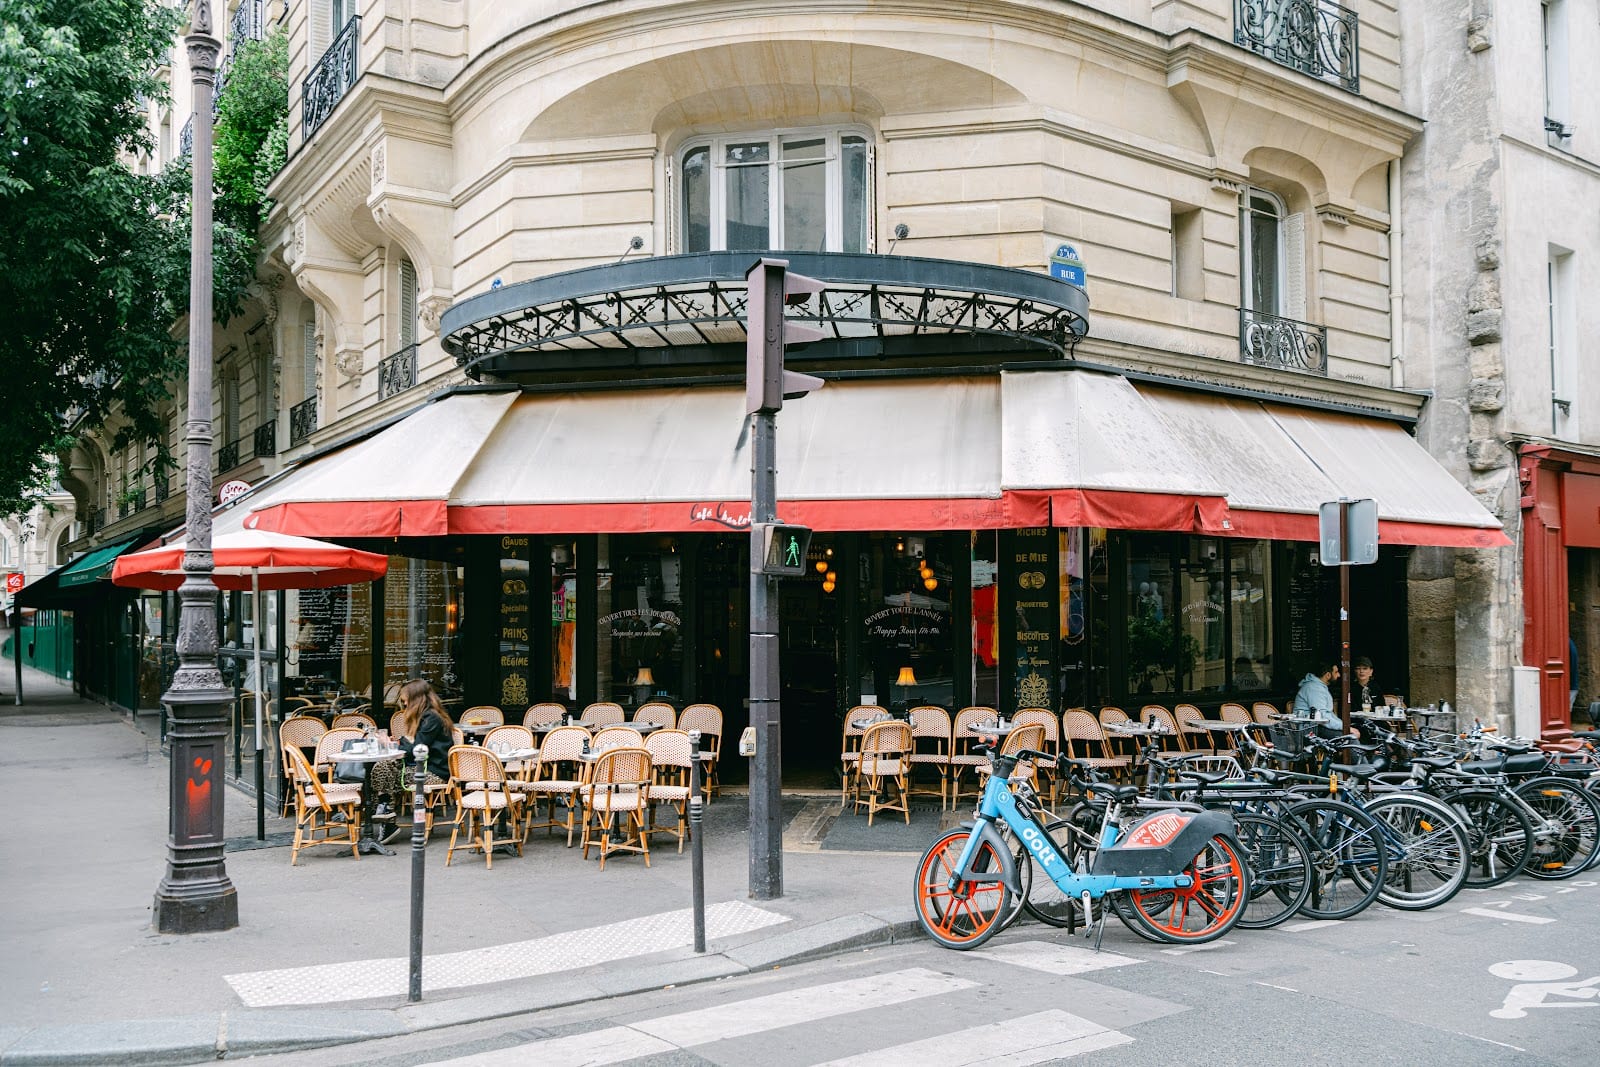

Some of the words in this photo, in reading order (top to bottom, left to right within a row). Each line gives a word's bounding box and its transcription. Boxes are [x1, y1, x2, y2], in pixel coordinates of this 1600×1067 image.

[1061, 269, 1076, 280] RUE
[690, 503, 713, 520] Café
[502, 536, 529, 550] CHAUDS
[1015, 553, 1028, 563] DE
[1029, 552, 1048, 563] MIE
[598, 611, 622, 625] OUVERT
[621, 608, 637, 618] TOUS
[637, 608, 649, 616] LES
[864, 608, 890, 626] OUVERT
[891, 606, 913, 616] TOUTE
[502, 627, 529, 641] PAINS
[873, 625, 898, 638] Happy
[898, 625, 917, 635] Hour
[1016, 631, 1050, 641] BISCOTTES
[1148, 815, 1181, 844] GRATUIT
[1023, 827, 1056, 867] dott
